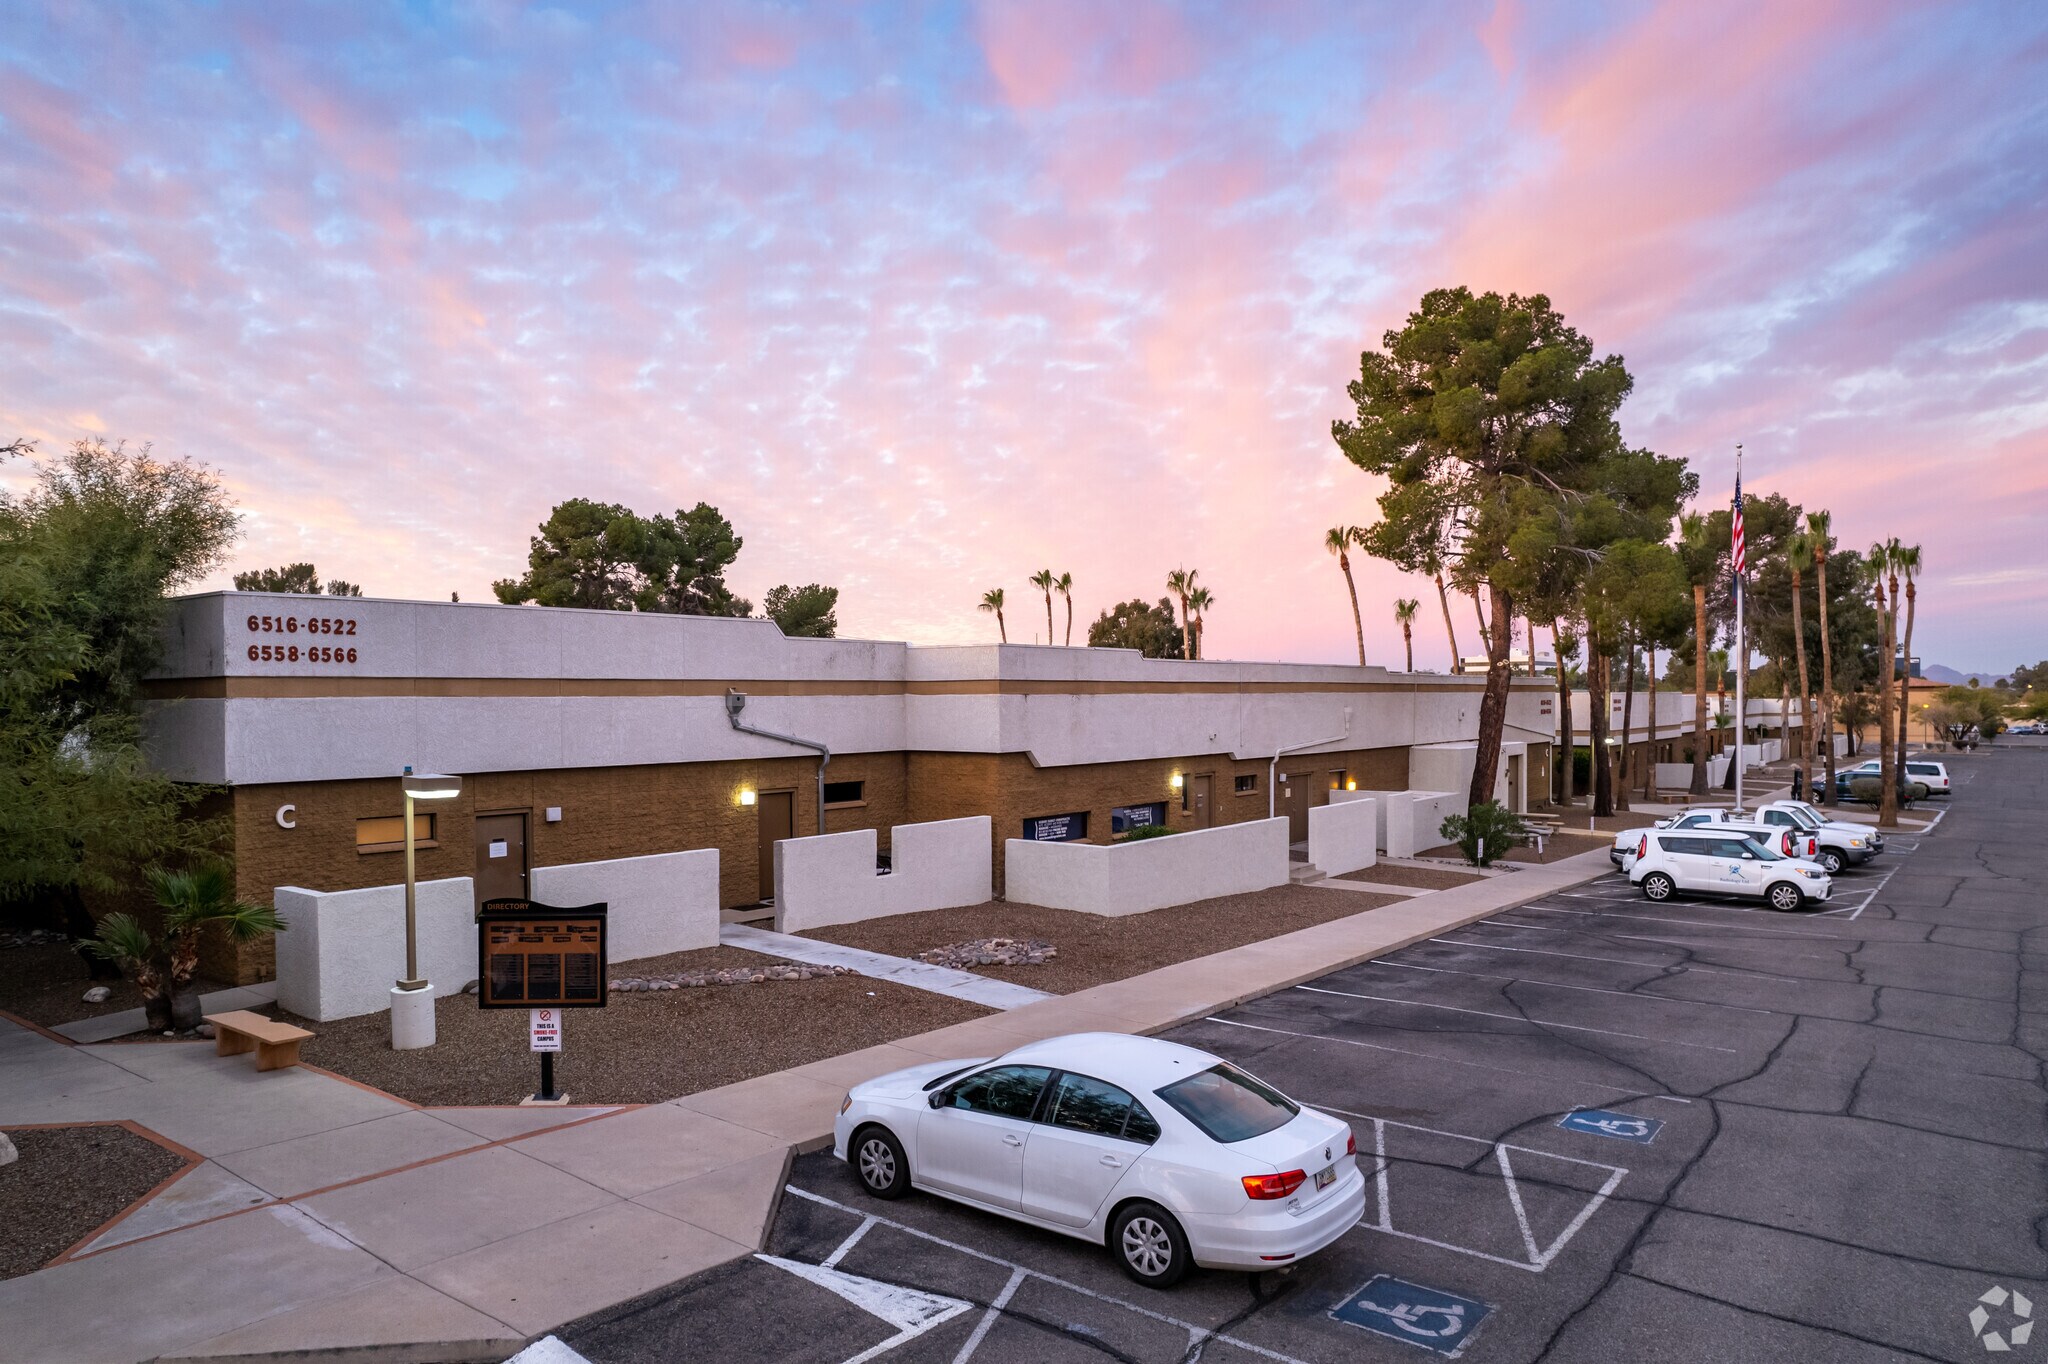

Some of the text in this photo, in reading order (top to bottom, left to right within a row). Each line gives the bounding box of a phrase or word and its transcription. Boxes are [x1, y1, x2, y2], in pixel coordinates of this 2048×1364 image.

[247, 615, 357, 635] 6516-6522
[247, 645, 358, 663] 6558-6566
[275, 804, 296, 829] C
